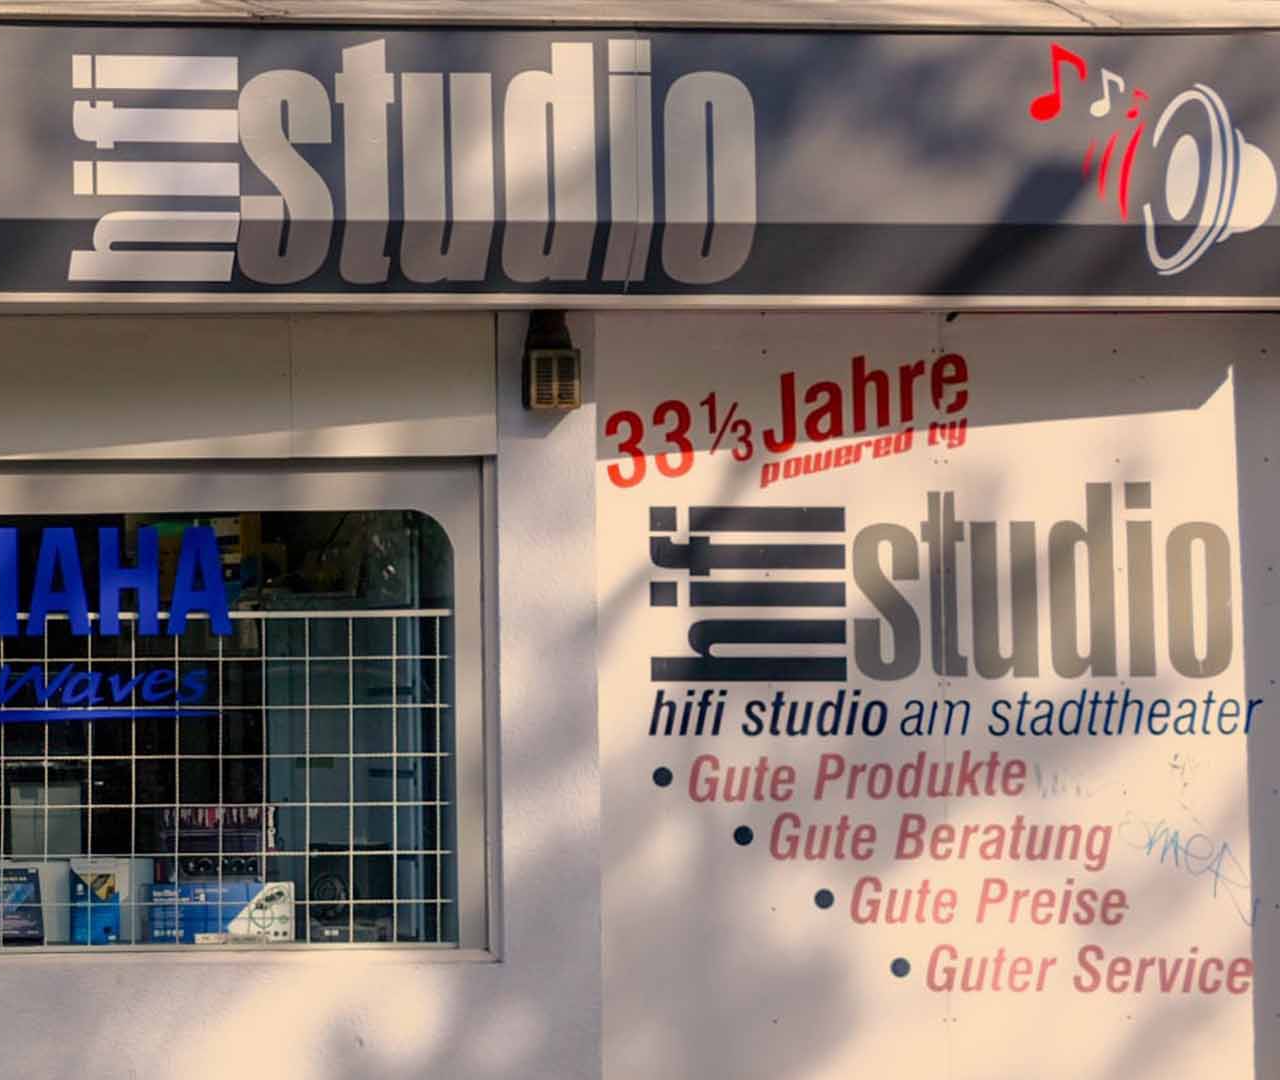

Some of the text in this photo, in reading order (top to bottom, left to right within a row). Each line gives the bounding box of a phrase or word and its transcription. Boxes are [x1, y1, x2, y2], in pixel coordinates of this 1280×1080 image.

[68, 38, 757, 285] hifi studio
[762, 353, 969, 454] Jahre
[760, 427, 915, 489] powered
[649, 481, 1233, 682] hifi studio
[648, 689, 1263, 738] hifi studio am stadttheater
[688, 750, 1028, 803] Gute Produkte
[768, 812, 877, 862] Gute
[895, 813, 1113, 873] Beratung
[849, 876, 1129, 926] Gute Preise
[925, 944, 1254, 995] Guter Service
